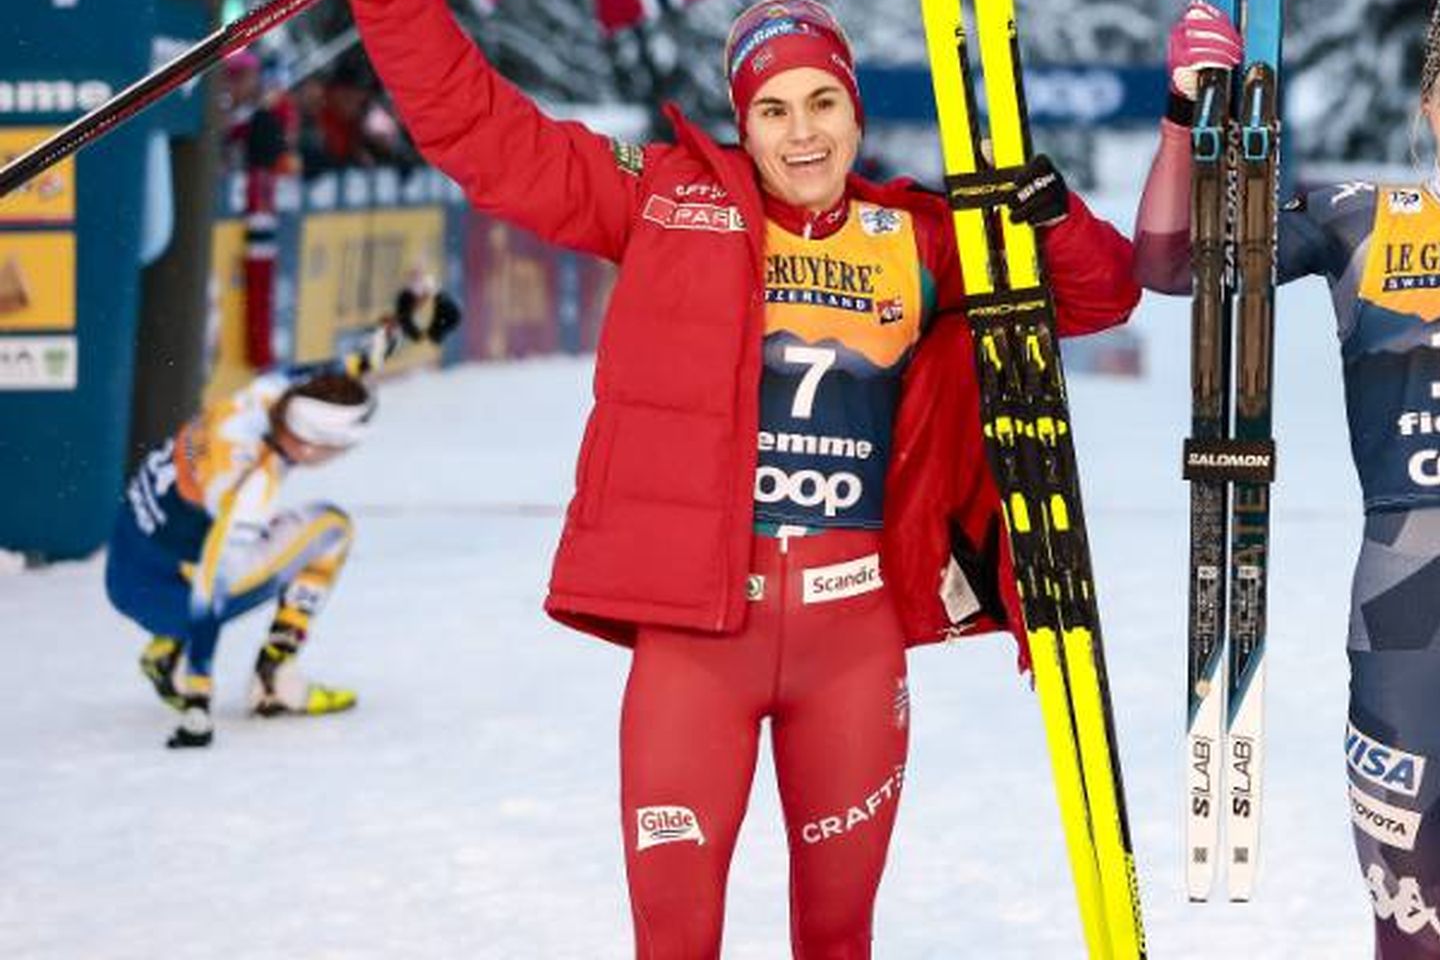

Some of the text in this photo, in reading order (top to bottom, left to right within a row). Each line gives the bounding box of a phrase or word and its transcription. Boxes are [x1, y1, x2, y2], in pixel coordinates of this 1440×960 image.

[1385, 243, 1414, 274] LE
[784, 346, 836, 419] 7
[1188, 452, 1271, 467] SALOMON
[640, 809, 695, 833] Gilde
[802, 776, 895, 843] CRAFT
